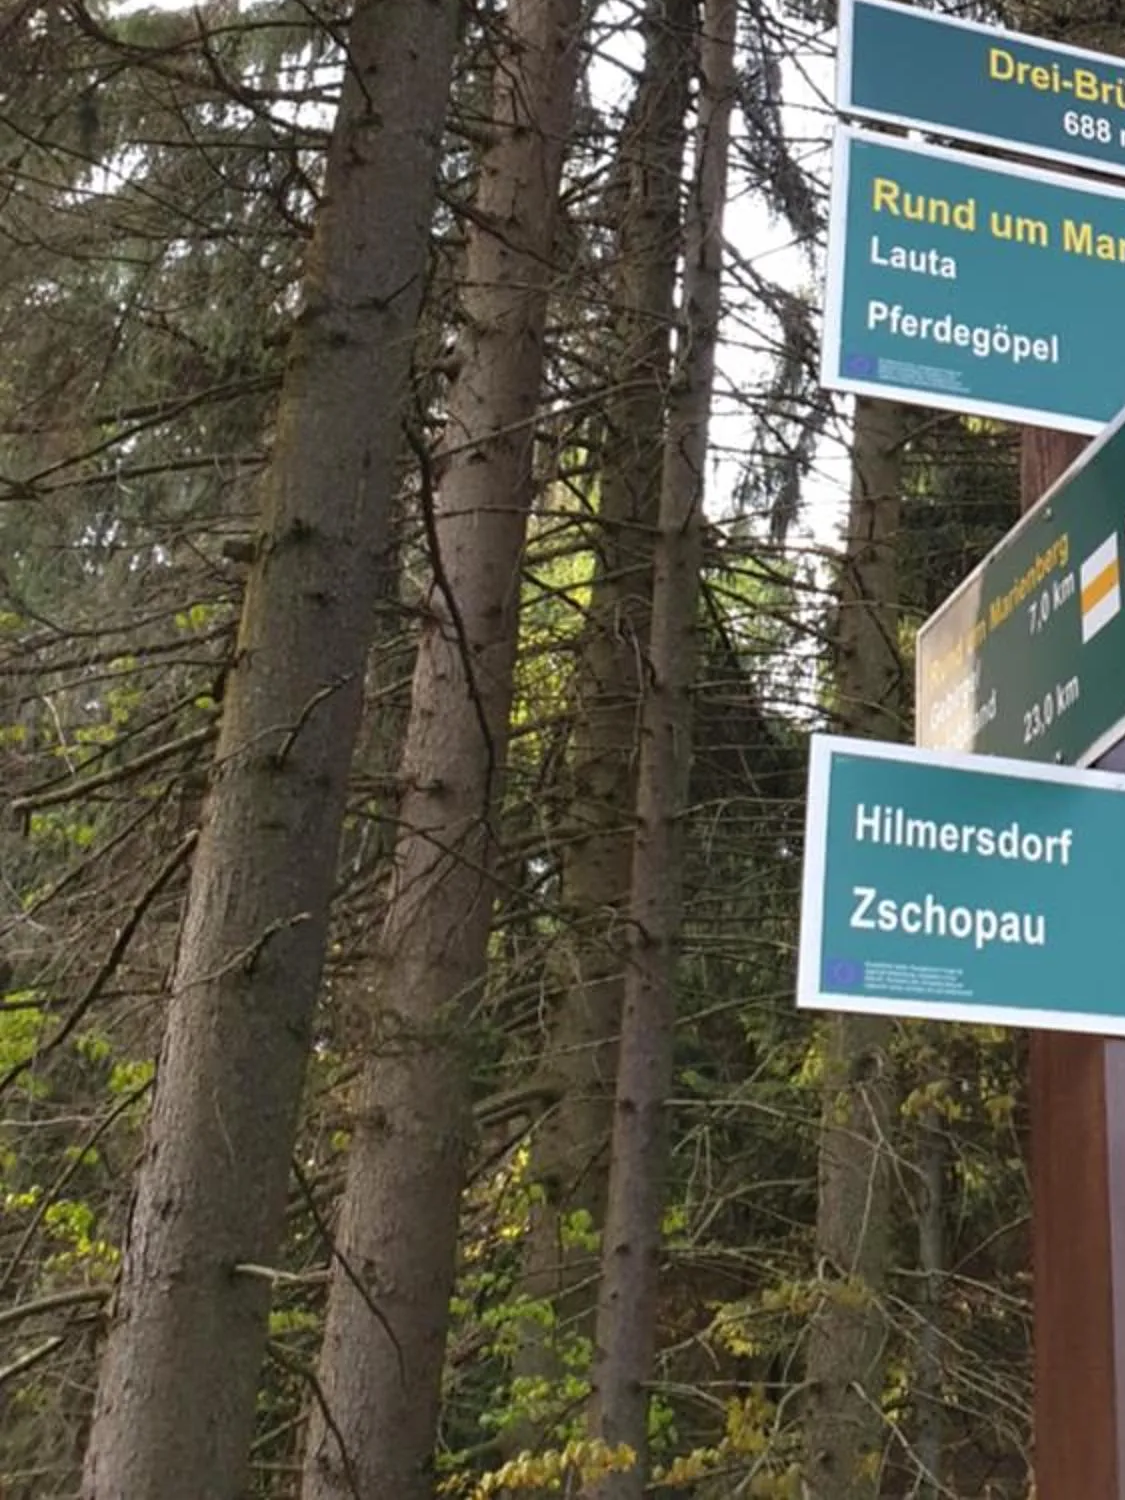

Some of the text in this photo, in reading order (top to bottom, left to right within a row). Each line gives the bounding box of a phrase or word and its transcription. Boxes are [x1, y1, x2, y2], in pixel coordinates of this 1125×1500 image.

[1063, 111, 1111, 143] 688
[872, 177, 976, 231] Rund
[990, 211, 1048, 247] um
[870, 235, 957, 279] Lauta
[867, 301, 1060, 364] Pferdegöpel
[1027, 571, 1076, 635] 7,0 km
[1024, 692, 1053, 744] 23,0
[1056, 675, 1079, 716] km
[855, 803, 1073, 866] Hilmersdorf
[850, 886, 1046, 950] Zschopau
